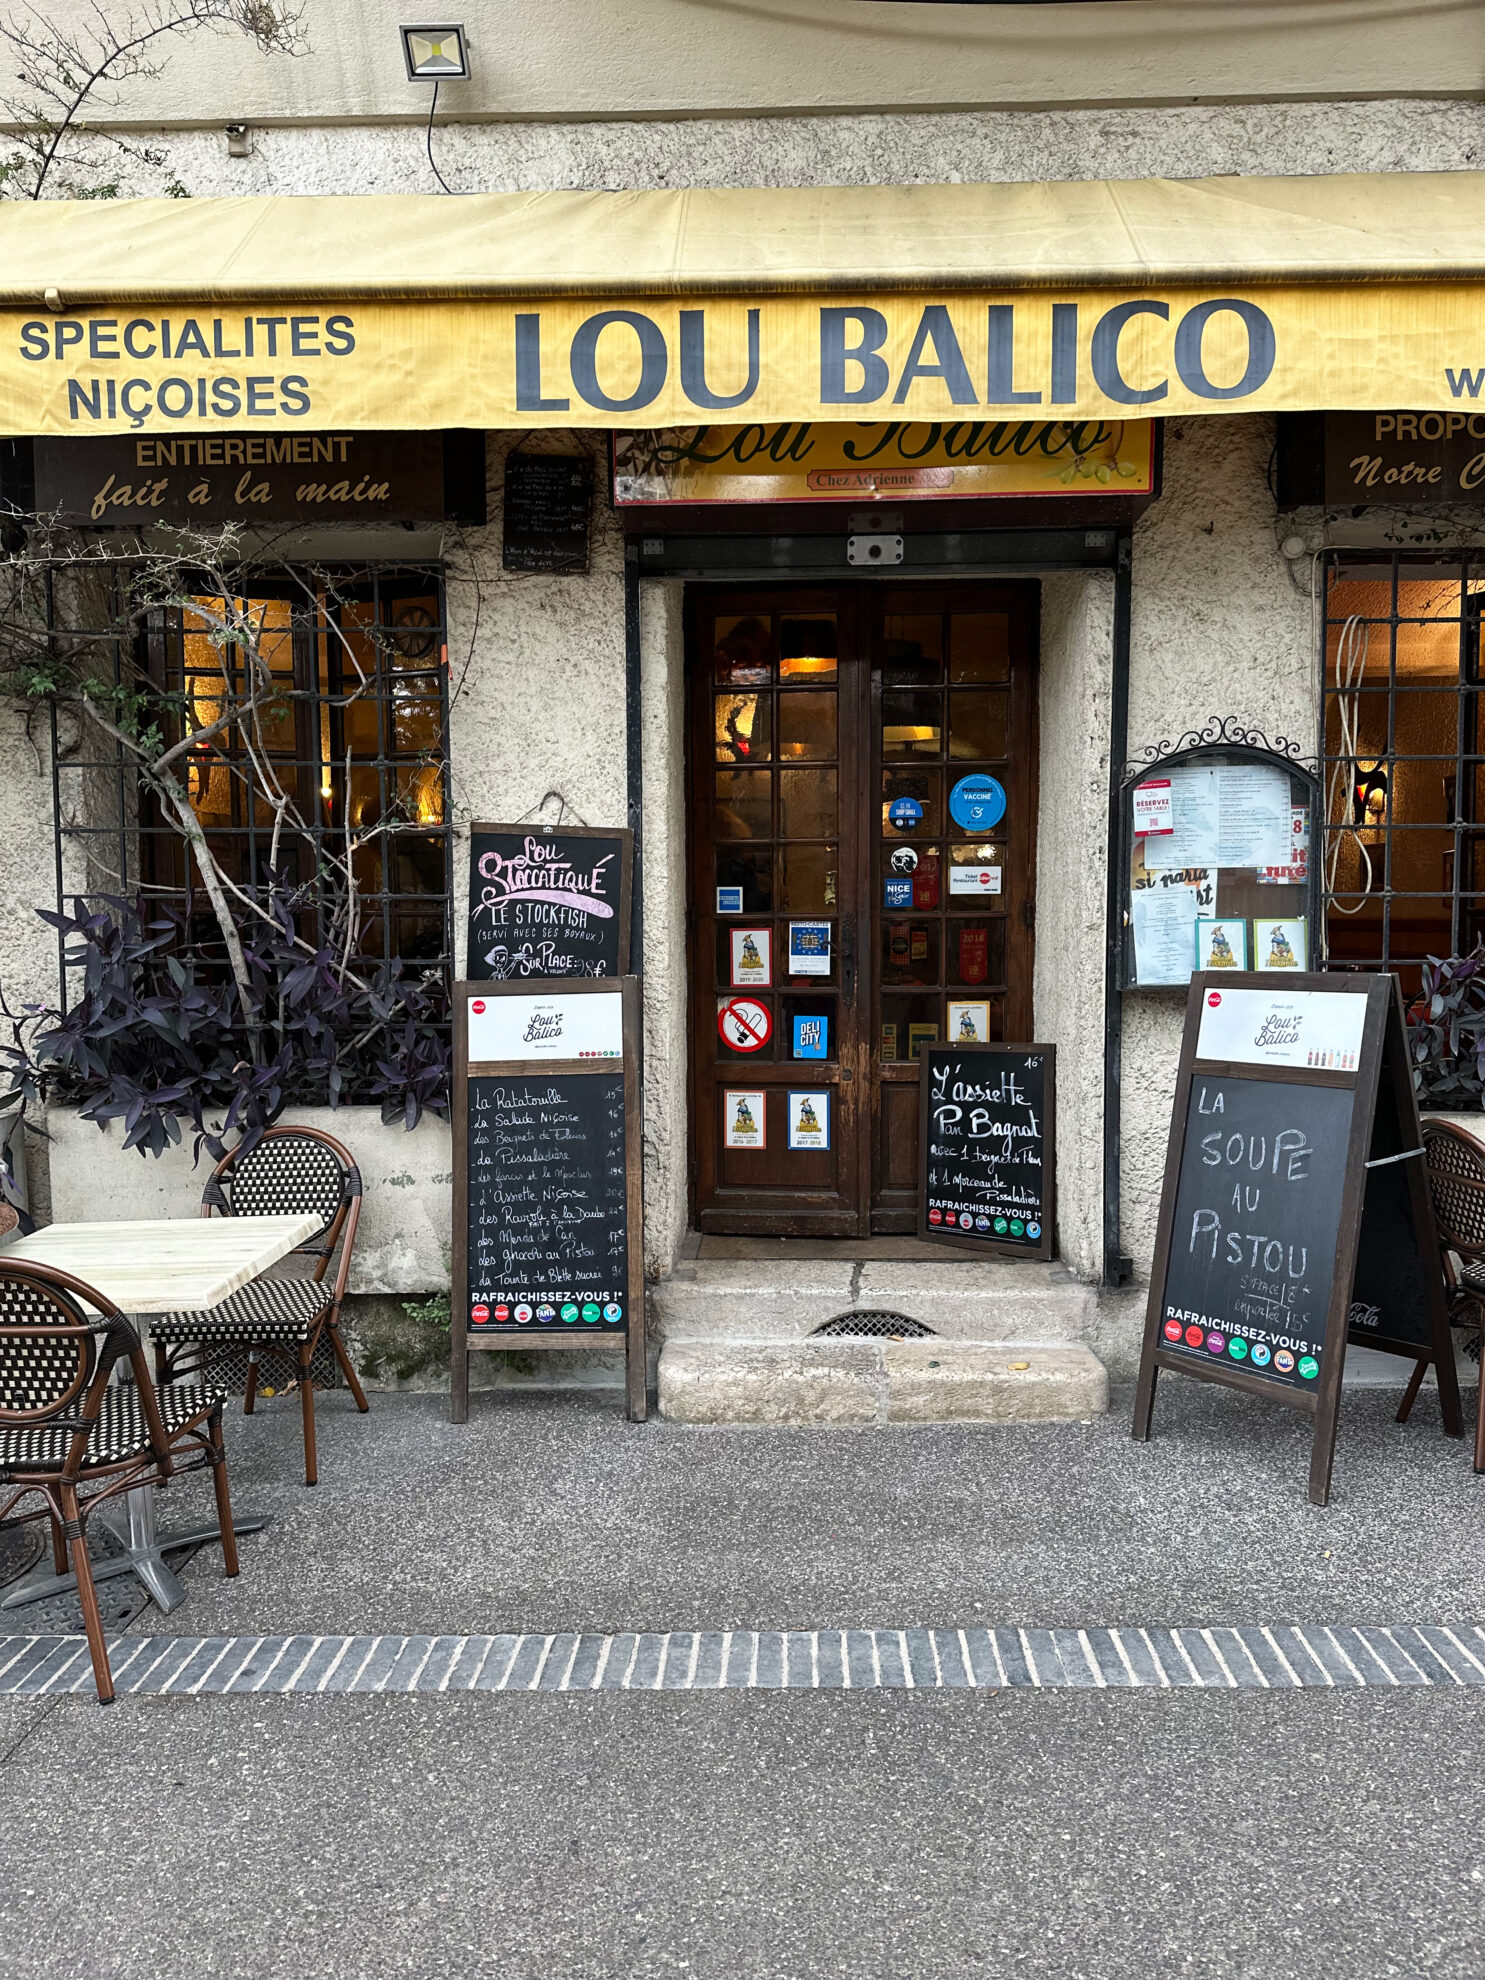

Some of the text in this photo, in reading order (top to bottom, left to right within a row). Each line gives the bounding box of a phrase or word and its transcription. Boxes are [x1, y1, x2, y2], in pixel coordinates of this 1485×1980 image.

[19, 315, 356, 361] SPECIALITES
[514, 298, 1277, 412] LOU BALICO
[67, 375, 312, 428] NIÇOISES
[136, 436, 354, 467] ENTIEREMENT
[816, 473, 915, 486] Chez Adrienne
[1349, 455, 1442, 488] Notre
[90, 470, 391, 520] fait à la main
[1136, 799, 1170, 807] RÉSERVEZ
[491, 903, 588, 928] LE STOCKFISH
[513, 928, 536, 938] AVEC
[542, 928, 559, 938] SES
[528, 1014, 555, 1030] Lou
[800, 1020, 821, 1035] DELI
[1261, 1014, 1293, 1033] Lou
[523, 1027, 563, 1042] Balico
[800, 1032, 822, 1046] CITY
[1254, 1031, 1300, 1046] Balico
[931, 1063, 1031, 1105] L'assiette
[475, 1088, 492, 1110] La
[493, 1088, 569, 1110] Ratatouille
[1198, 1087, 1225, 1114] LA
[495, 1111, 536, 1127] Salade
[493, 1129, 535, 1150] Beignets
[933, 1104, 1042, 1156] Pan Bagnat
[495, 1146, 571, 1165] Pissaladière
[930, 1144, 959, 1156] avec
[960, 1144, 970, 1160] 1
[1200, 1128, 1314, 1181] SOUPE
[527, 1171, 538, 1181] et
[543, 1166, 551, 1178] le
[943, 1168, 951, 1185] 1
[992, 1173, 1008, 1188] de
[543, 1185, 589, 1203] Niçoise
[1231, 1183, 1260, 1214] AU
[550, 1209, 559, 1220] à
[563, 1205, 576, 1219] la
[929, 1198, 1032, 1220] RAFRAICHISSEZ-VOUS
[537, 1228, 550, 1243] de
[546, 1252, 561, 1260] au
[495, 1270, 530, 1285] Tourte
[532, 1272, 547, 1283] de
[471, 1291, 611, 1302] RAFRAICHISSEZ-VOUS
[1166, 1306, 1309, 1353] RAFRAICHISSEZ-VOUS
